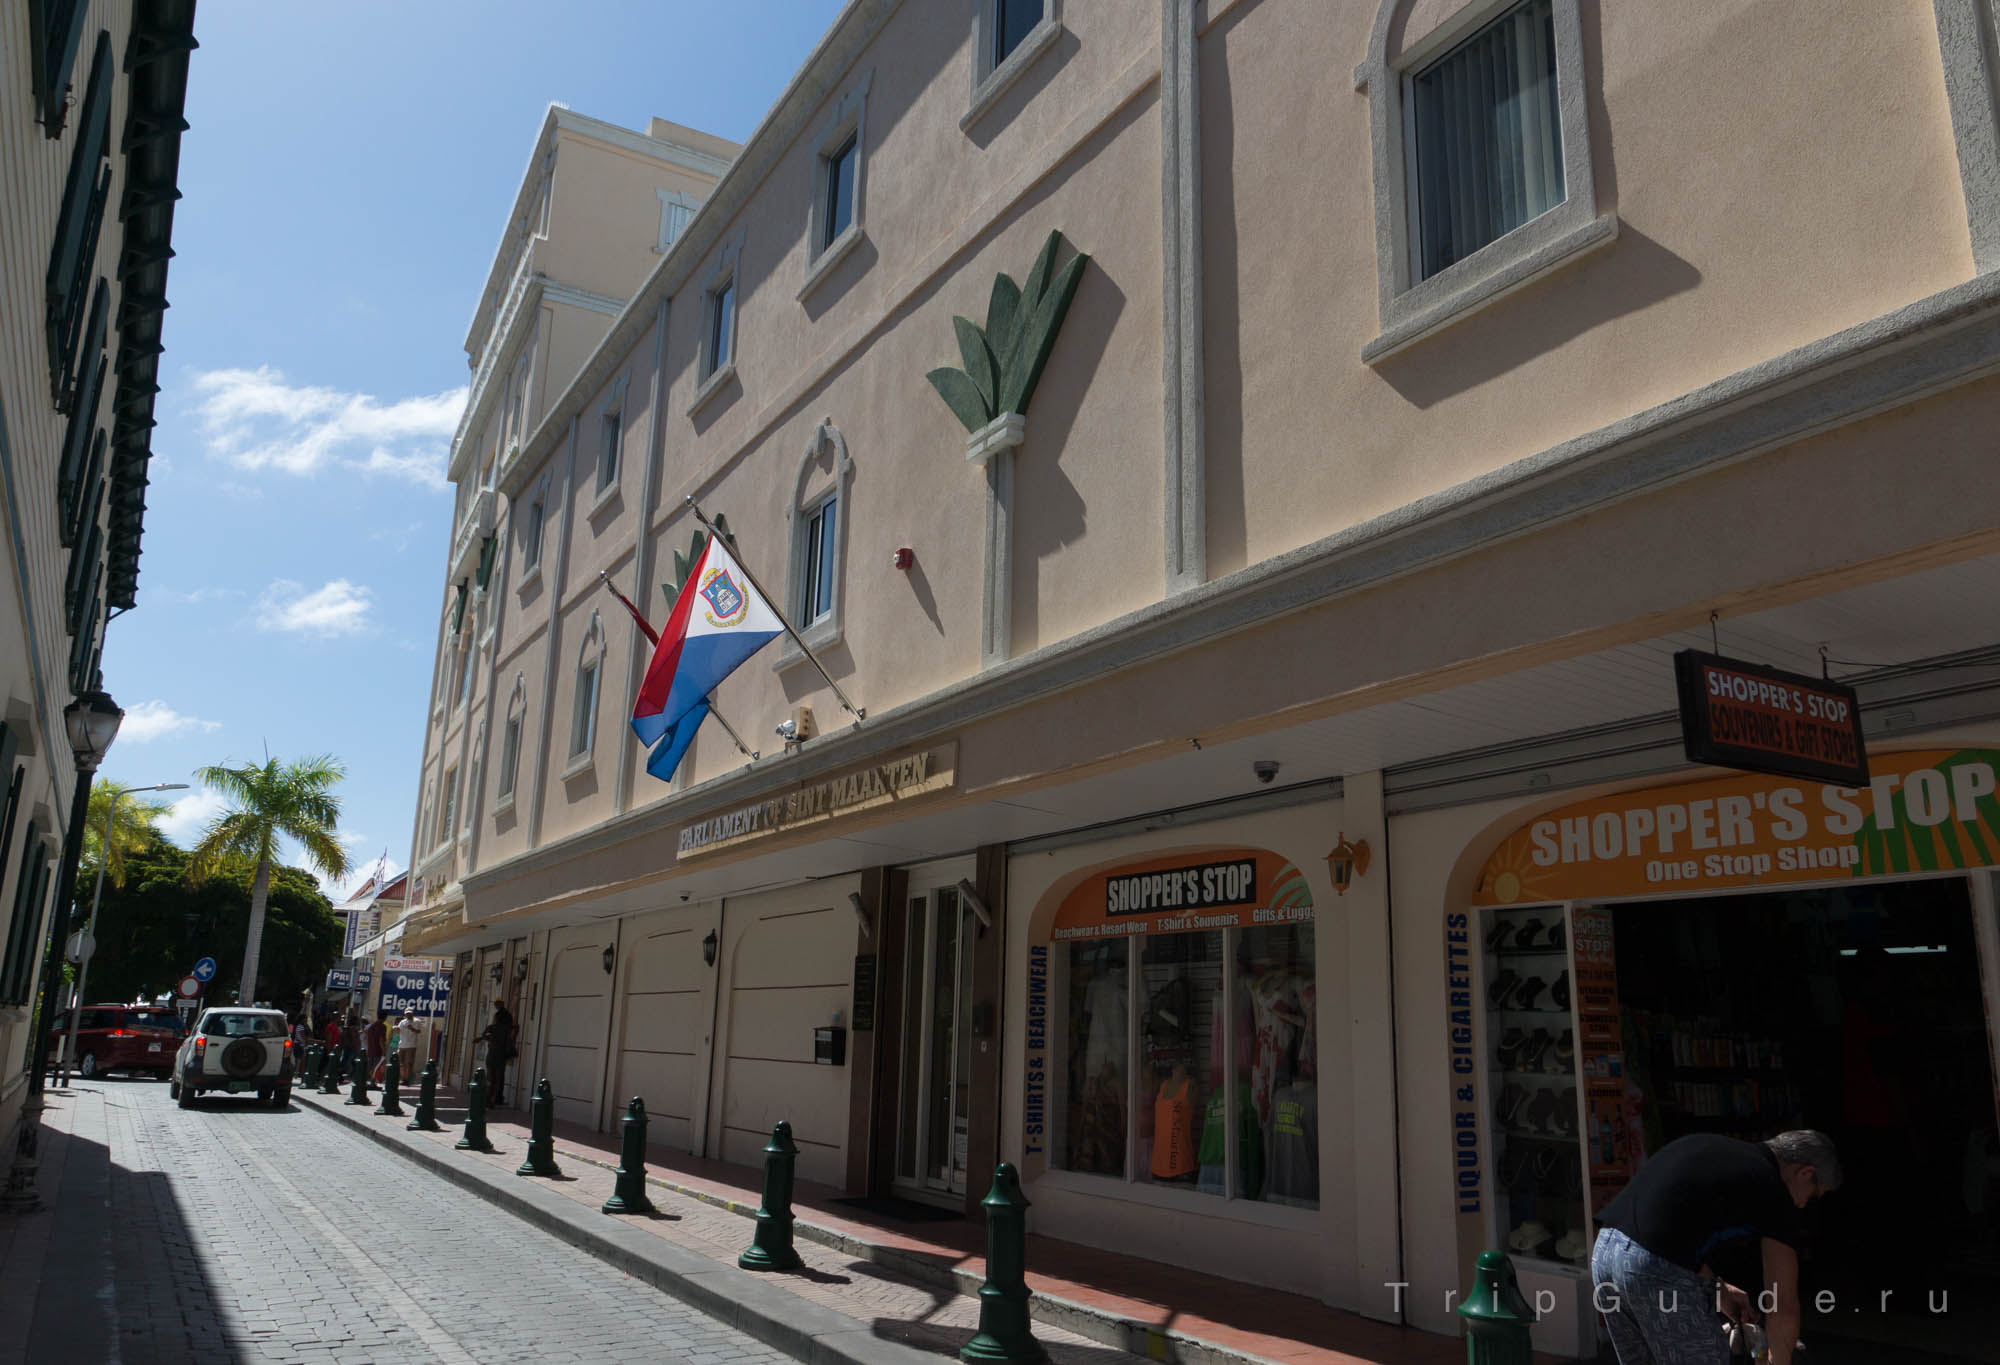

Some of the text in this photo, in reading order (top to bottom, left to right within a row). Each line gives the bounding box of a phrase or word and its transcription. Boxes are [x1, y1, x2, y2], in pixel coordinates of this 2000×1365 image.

[1708, 671, 1848, 723] SHOPPER'S STOP
[1711, 703, 1783, 748] SOUVENIRS
[1795, 721, 1821, 756] GIFT
[680, 803, 761, 850] PARLIAMENT
[786, 783, 828, 822] SINT
[830, 752, 929, 810] MAARTEN
[1531, 763, 1996, 867] SHOPPER'S STOP
[1645, 843, 1860, 883] One Stop Shop
[1108, 864, 1252, 912] SHOPPER'S STOP
[1101, 921, 1126, 936] Resort
[1126, 920, 1149, 934] Wear
[1186, 917, 1193, 929] &
[1194, 911, 1240, 928] Souvenirs
[1252, 906, 1276, 922] Gifts
[1277, 907, 1285, 920] &
[396, 975, 425, 990] One
[1028, 946, 1047, 1049] BEACHWEAR
[1029, 1057, 1044, 1069] &
[1447, 913, 1481, 1213] LIQUOR & CIGARETTES
